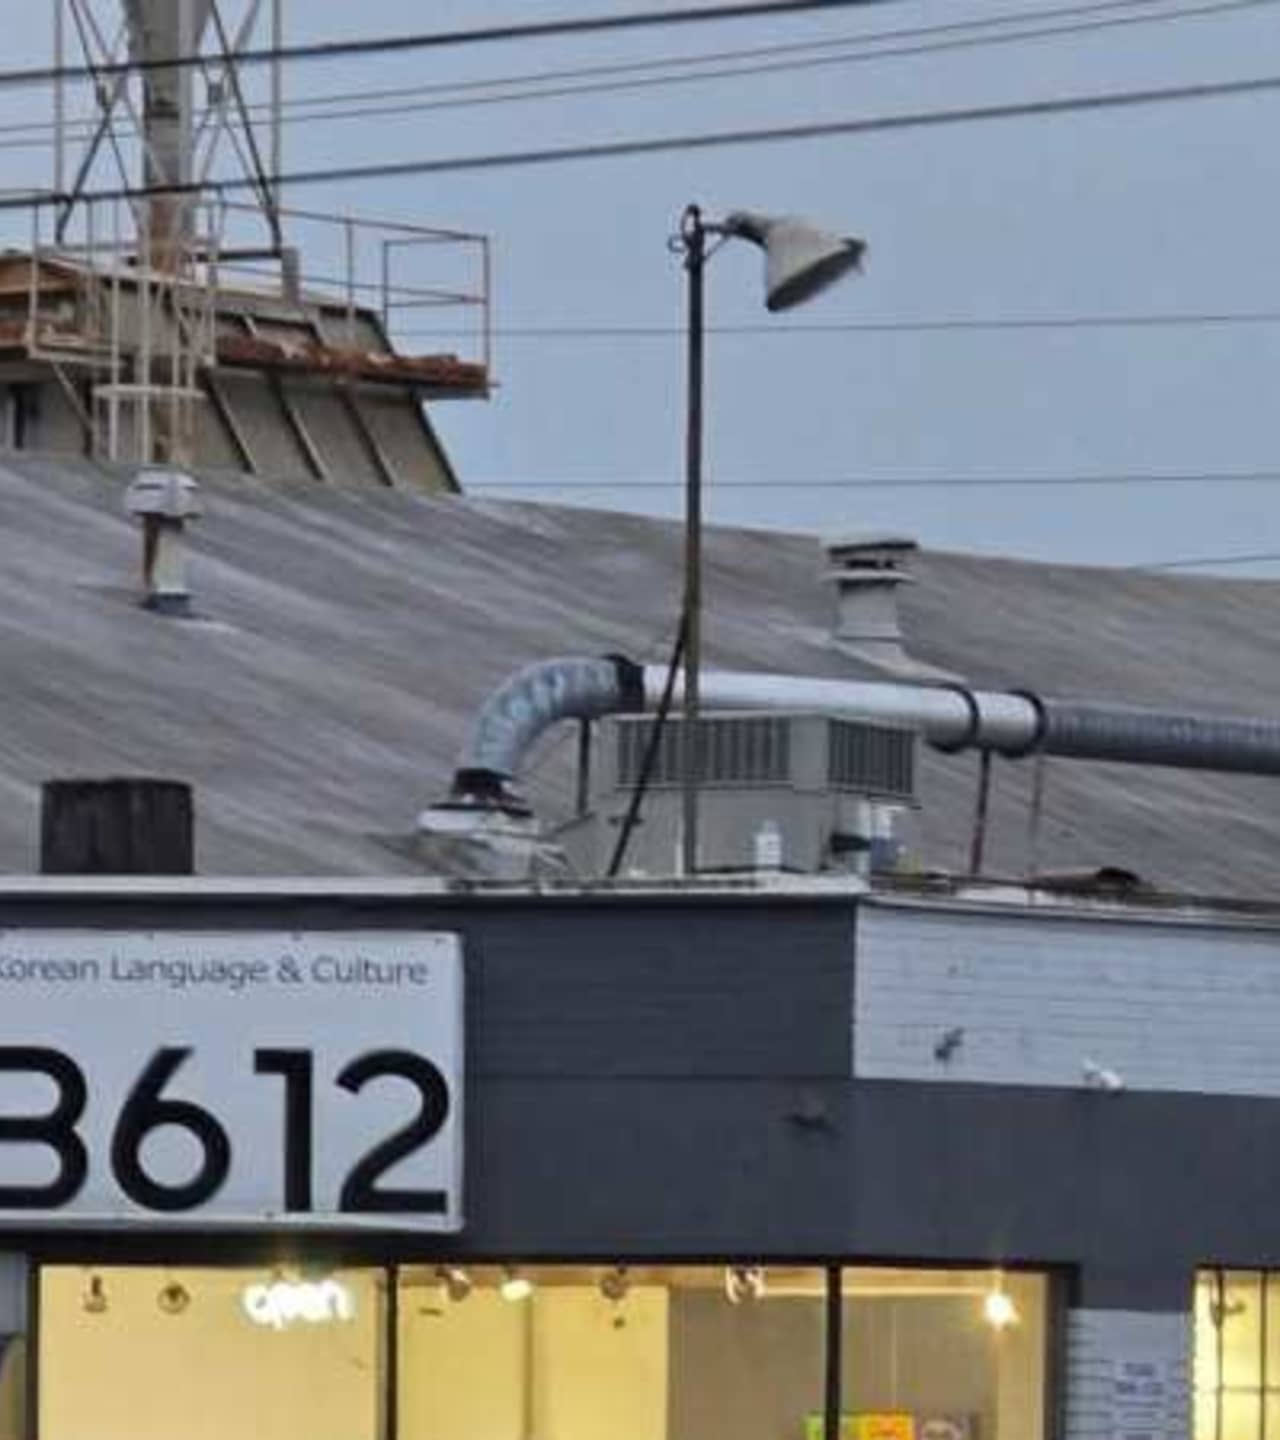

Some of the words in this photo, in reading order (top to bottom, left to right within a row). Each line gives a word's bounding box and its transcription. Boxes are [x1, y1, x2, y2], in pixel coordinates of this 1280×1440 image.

[110, 954, 269, 989] Language
[276, 956, 304, 984] &
[311, 954, 429, 986] Culture
